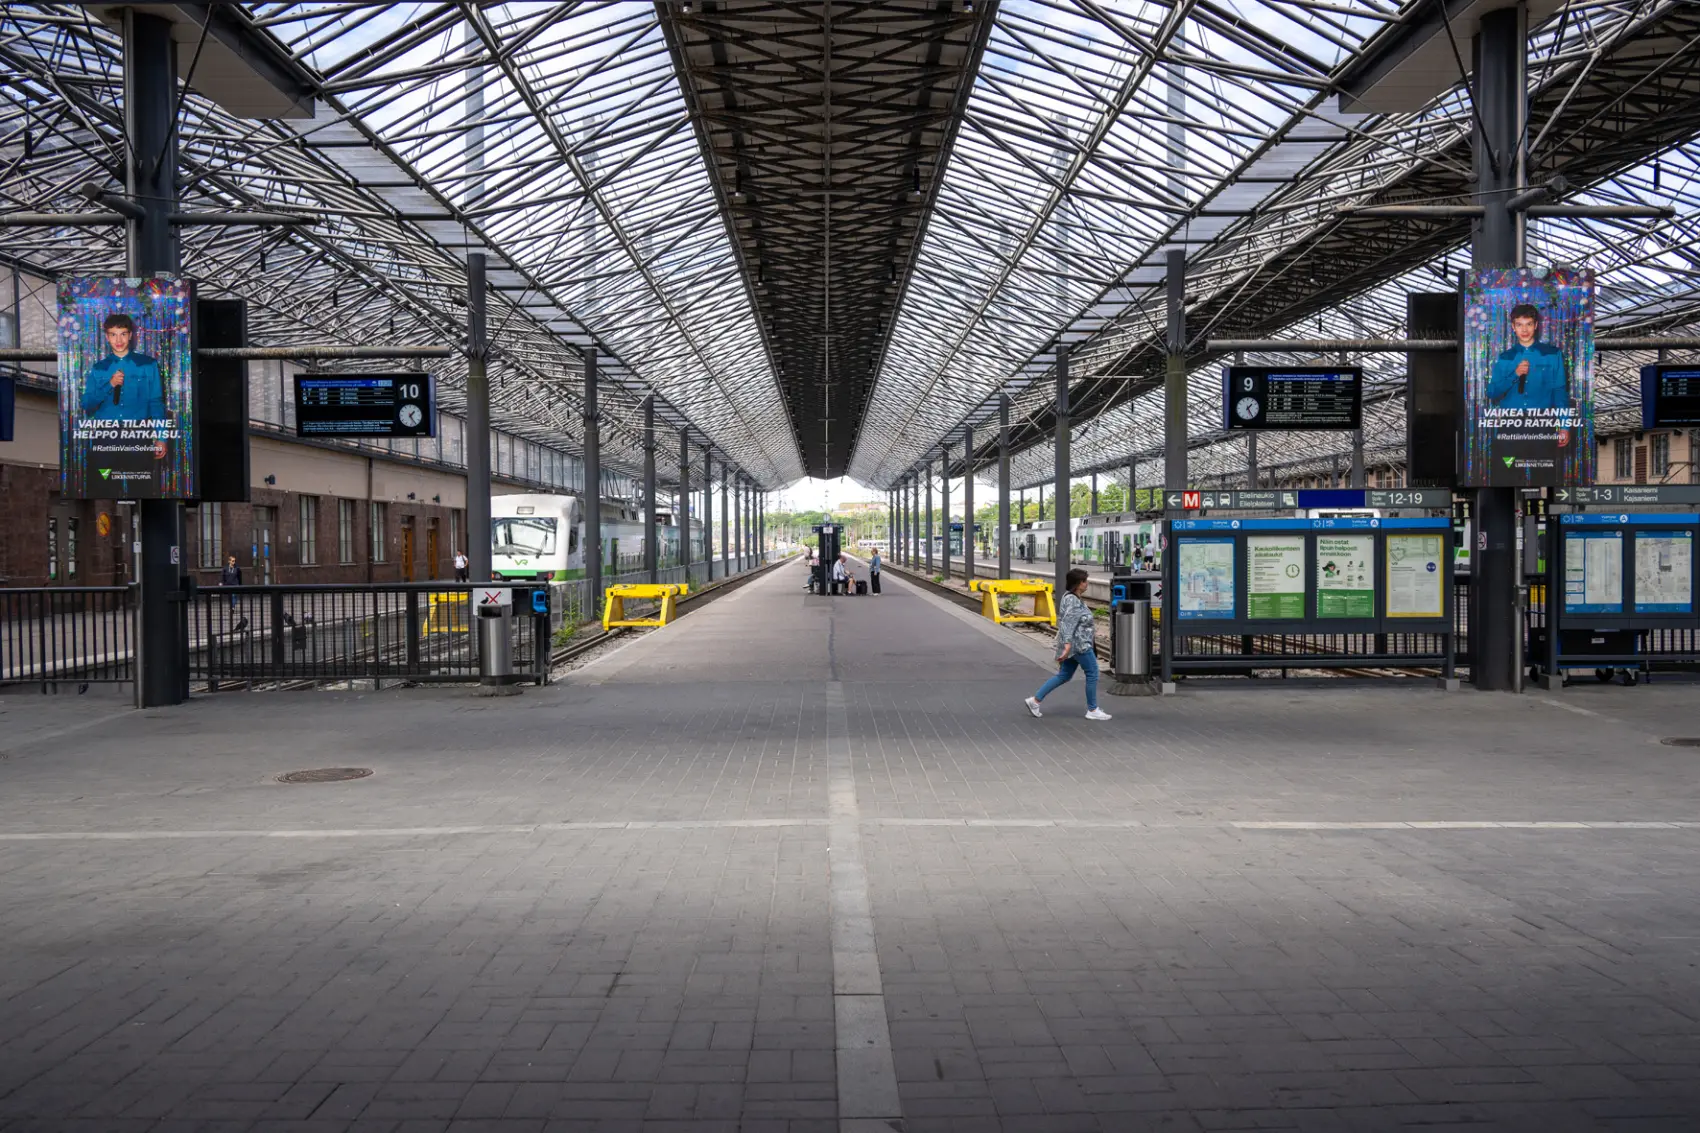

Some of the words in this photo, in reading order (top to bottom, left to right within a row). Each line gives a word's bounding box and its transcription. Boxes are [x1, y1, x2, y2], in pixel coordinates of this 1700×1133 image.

[1243, 377, 1254, 391] 9
[400, 384, 419, 399] 10
[1483, 408, 1524, 417] VAIKEA
[1527, 408, 1579, 417] TILANNE.
[78, 419, 120, 428] VAIKEA
[122, 419, 176, 428] TILANNE.
[1478, 418, 1522, 428] HELPPO
[1524, 418, 1584, 428] RATKAISU.
[72, 430, 118, 439] HELPPO
[120, 430, 181, 439] RATKAISU.
[1239, 491, 1275, 499] Elielinaukio
[1388, 493, 1423, 505] 12-19
[1593, 489, 1612, 500] 1-3
[1623, 495, 1658, 503] Kajsaniemi
[1183, 493, 1198, 508] M
[1239, 500, 1275, 508] Elielplatsen
